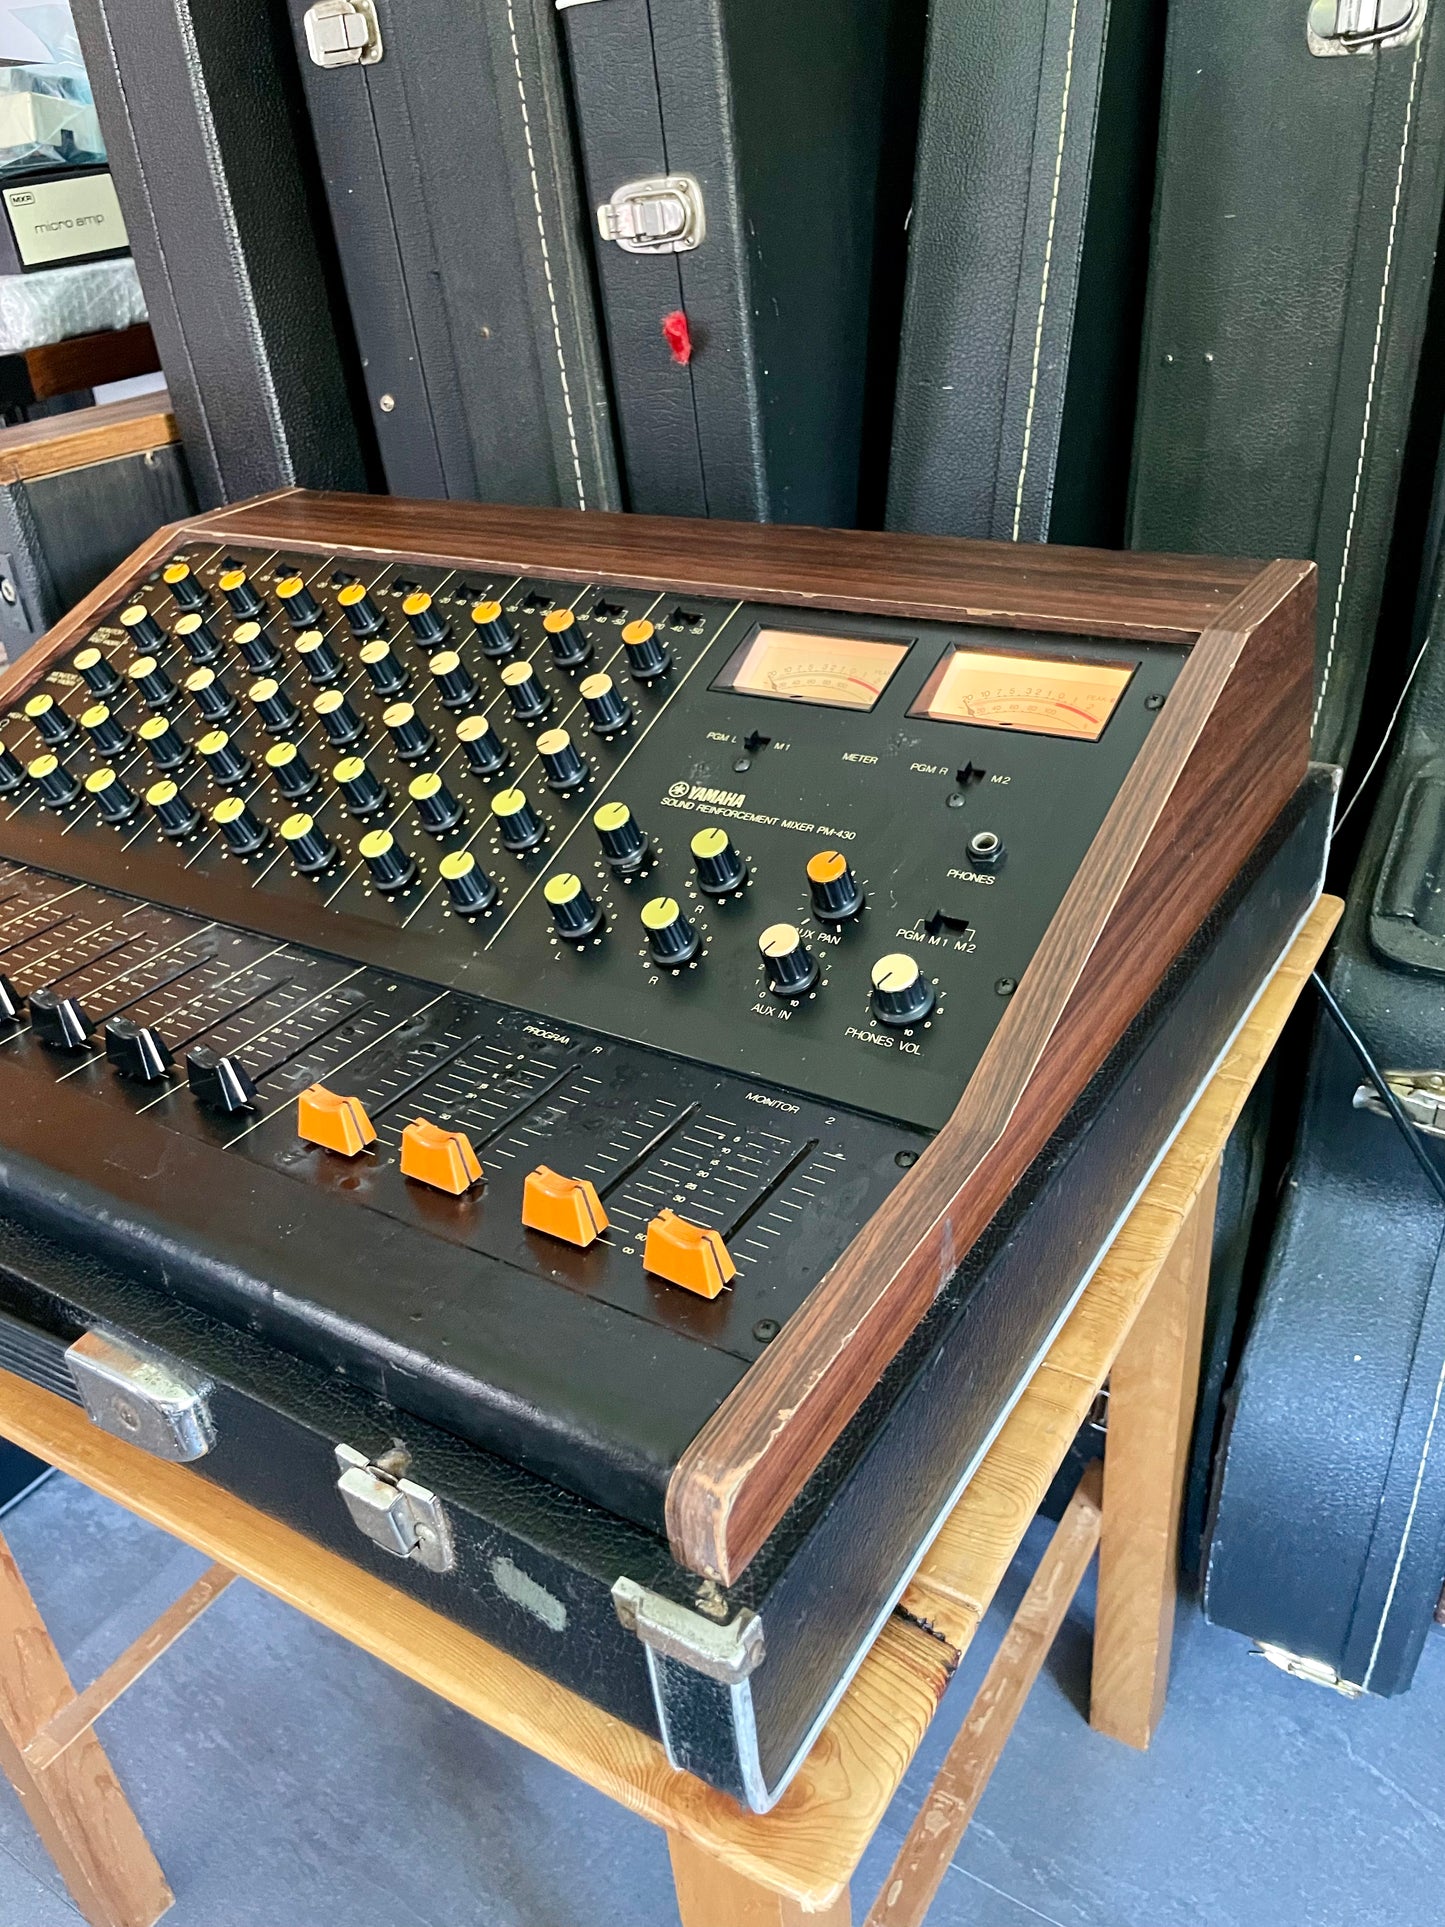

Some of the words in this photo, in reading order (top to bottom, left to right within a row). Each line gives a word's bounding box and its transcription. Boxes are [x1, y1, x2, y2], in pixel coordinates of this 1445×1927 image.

[13, 195, 32, 203] MXR
[34, 219, 74, 234] micro
[76, 214, 104, 226] amp
[706, 732, 730, 742] PGM
[730, 736, 736, 744] L
[842, 752, 878, 764] METER
[910, 762, 938, 774] PGM
[938, 766, 948, 776] R
[990, 774, 1012, 784] M2
[687, 785, 747, 808] YAMAHA
[660, 798, 695, 810] SOUND
[696, 804, 780, 826] REINFORCEMENT
[780, 820, 816, 833] MIXER
[816, 826, 857, 841] PM-430
[946, 868, 996, 884] PHONES
[602, 884, 610, 892] L
[694, 904, 704, 914] R
[798, 926, 813, 941] UX
[816, 931, 842, 946] PAN
[895, 928, 926, 943] PGM
[954, 942, 978, 954] M2
[554, 952, 562, 960] L
[648, 976, 658, 984] R
[790, 1000, 800, 1008] 10
[750, 1003, 776, 1017] AUX
[777, 1010, 793, 1022] IN
[523, 1024, 570, 1046] PROGRAM
[904, 1028, 914, 1036] 10
[844, 1026, 895, 1048] PHONES
[898, 1040, 923, 1056] VOL
[744, 1092, 800, 1115] MONITOR
[824, 1116, 836, 1124] 2
[696, 1170, 710, 1178] 20
[672, 1194, 686, 1202] 30
